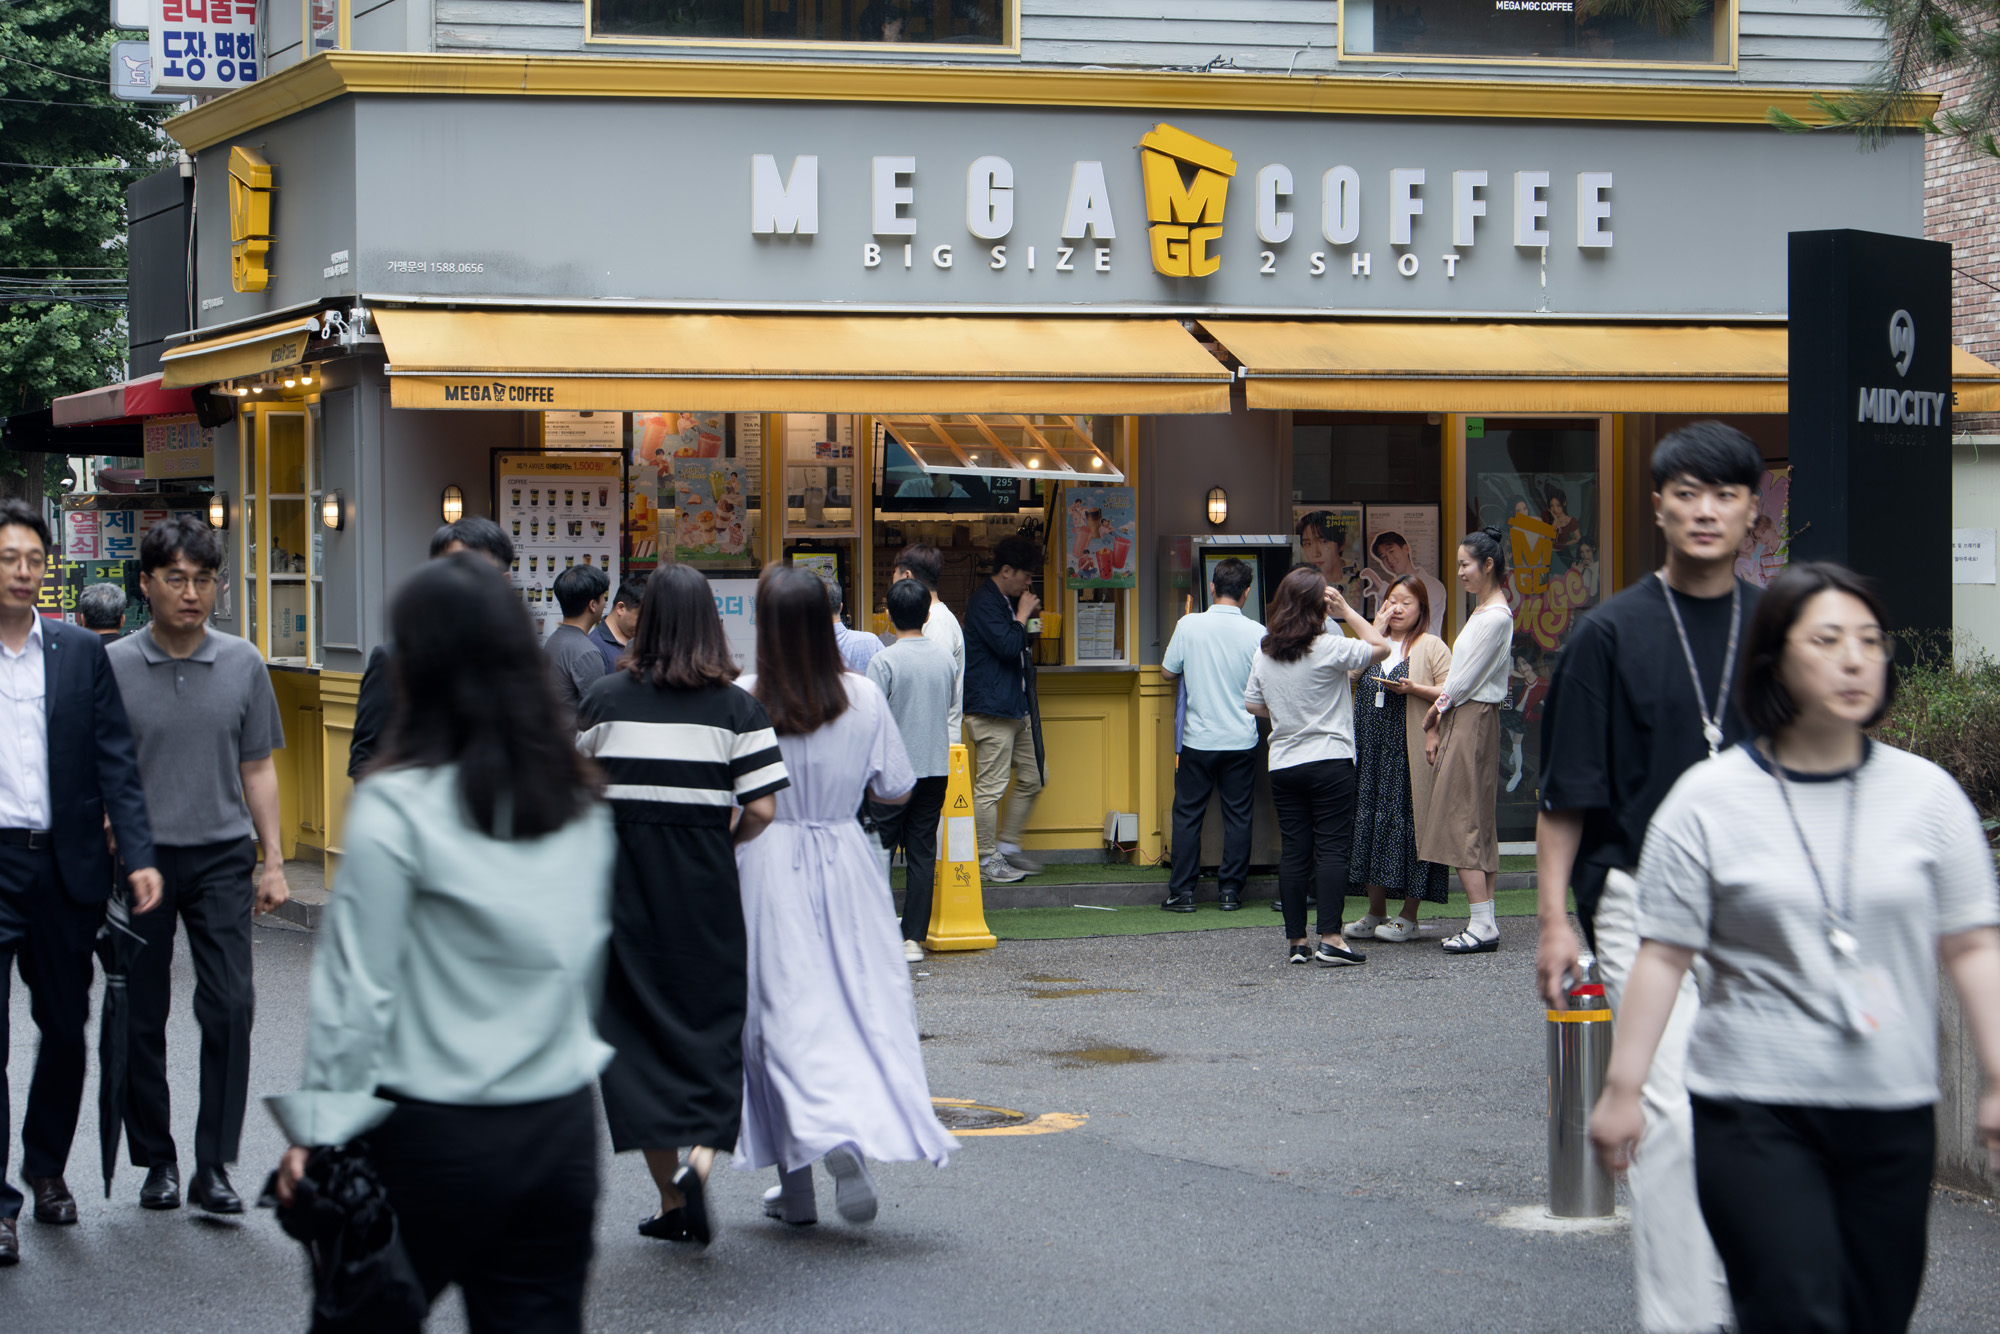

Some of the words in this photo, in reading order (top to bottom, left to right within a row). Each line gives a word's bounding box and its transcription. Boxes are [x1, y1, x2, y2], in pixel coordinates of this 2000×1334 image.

[1496, 1, 1520, 10] MEGA
[1521, 2, 1540, 11] MGC
[1541, 2, 1573, 12] COFFEE
[750, 153, 1116, 240] MEGA
[1255, 163, 1614, 249] COFFEE
[387, 261, 427, 273] 가맹문의
[430, 262, 484, 273] 1588.0656
[863, 243, 954, 268] BIG
[990, 245, 1112, 272] SIZE
[444, 385, 492, 401] MEGA
[508, 386, 554, 402] COFFEE
[1858, 387, 1946, 427] MIDCITY
[996, 478, 1013, 487] 295
[998, 496, 1009, 504] 79
[104, 510, 136, 559] 제본
[36, 584, 79, 610] 도장
